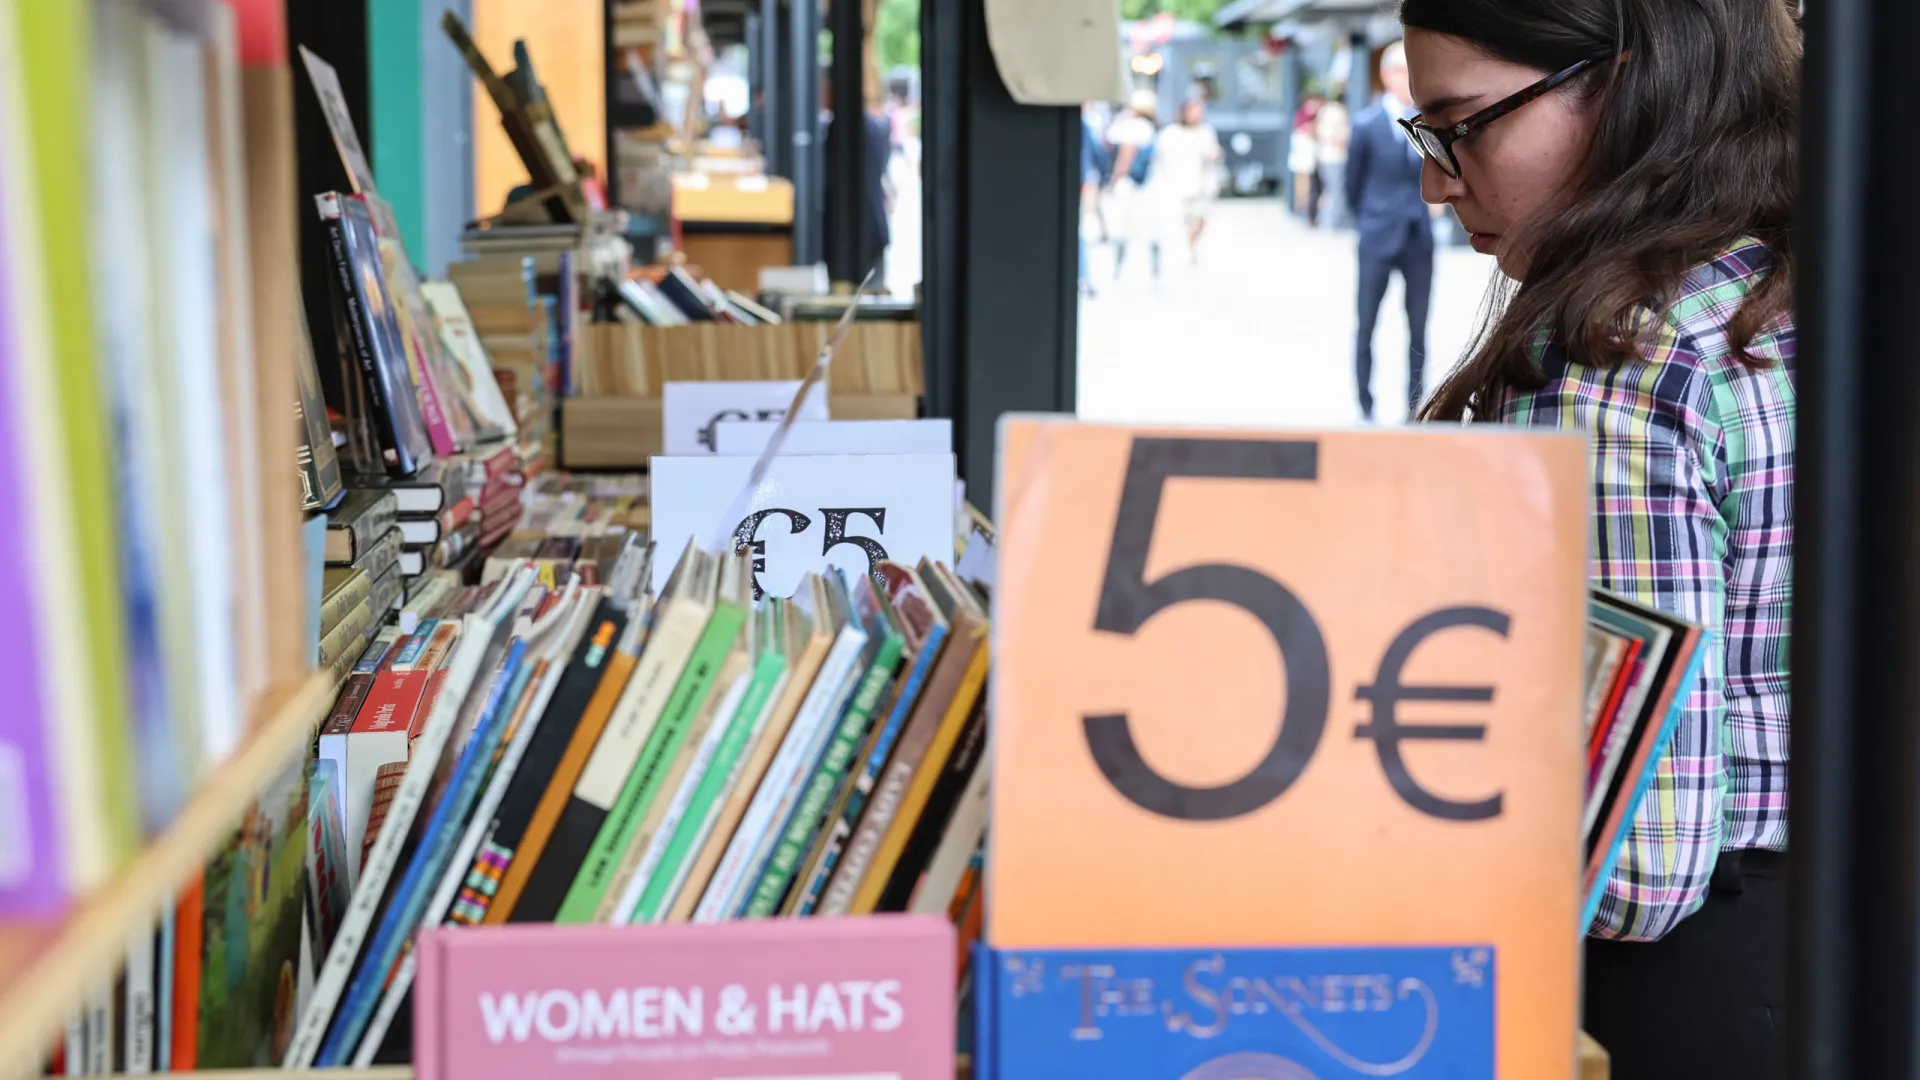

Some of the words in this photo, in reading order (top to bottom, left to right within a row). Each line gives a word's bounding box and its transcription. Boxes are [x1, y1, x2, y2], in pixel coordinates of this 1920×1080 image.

[480, 985, 700, 1042] WOMEN
[715, 983, 757, 1035] &
[768, 980, 903, 1032] HATS
